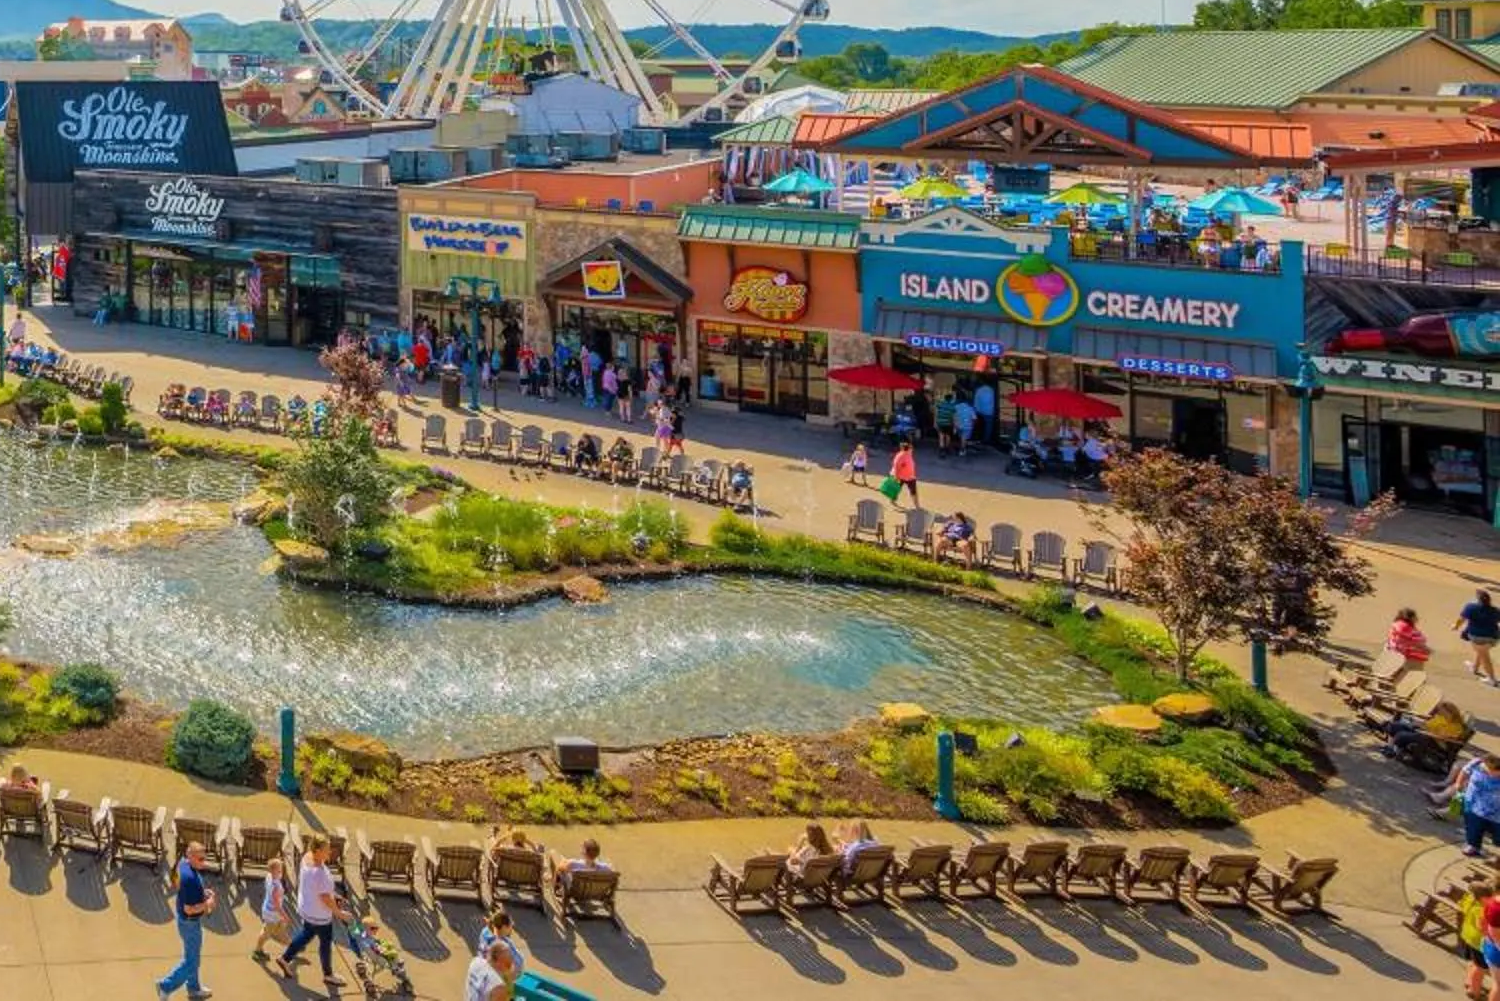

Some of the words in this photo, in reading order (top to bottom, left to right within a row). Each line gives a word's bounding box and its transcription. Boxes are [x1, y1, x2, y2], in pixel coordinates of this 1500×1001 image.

[107, 86, 152, 114] Ole
[57, 92, 189, 149] Smoky
[80, 144, 180, 164] Moonshine
[145, 181, 225, 222] Smoky
[175, 177, 201, 197] Ole
[150, 217, 217, 237] Moonshine
[899, 272, 990, 303] ISLAND
[1086, 290, 1240, 329] CREAMERY
[910, 335, 1000, 355] DELICIOUS
[1122, 357, 1227, 379] DESSERTS
